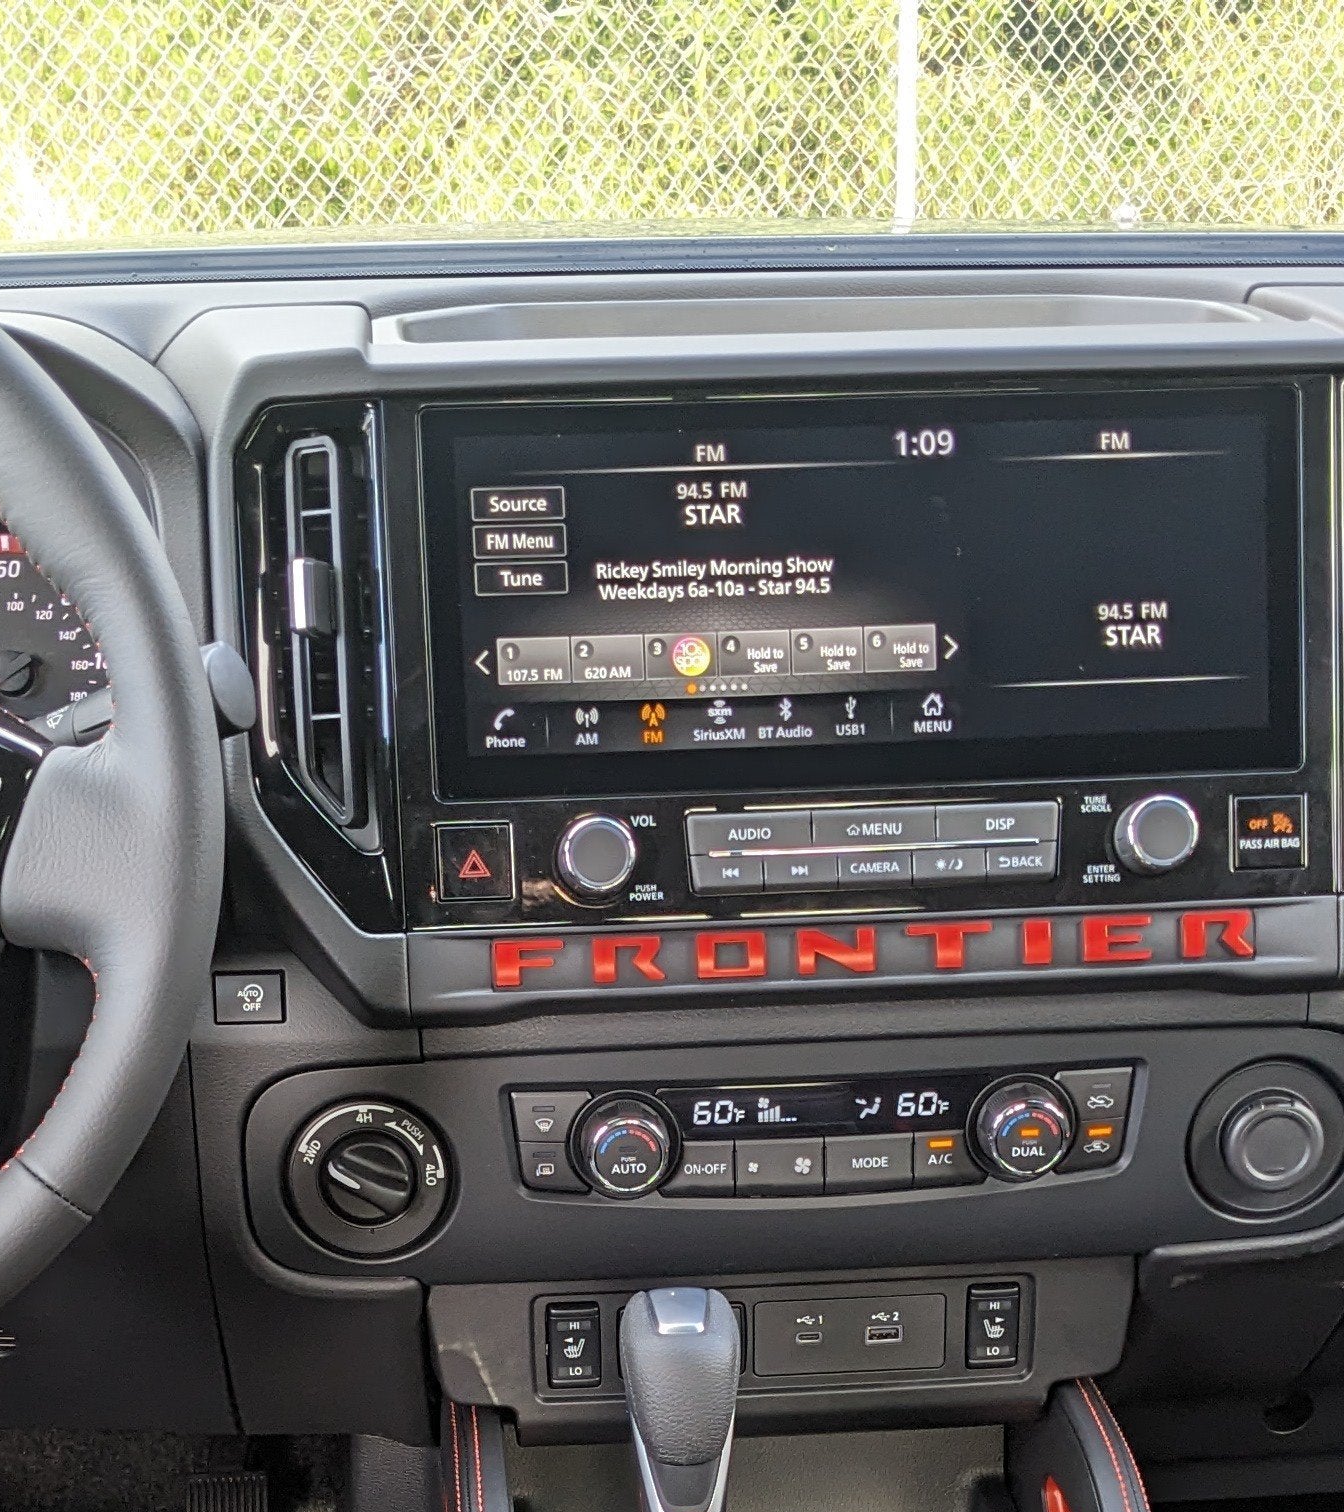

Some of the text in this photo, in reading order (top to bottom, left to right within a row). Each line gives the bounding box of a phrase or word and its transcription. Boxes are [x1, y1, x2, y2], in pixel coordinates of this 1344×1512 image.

[894, 429, 955, 457] 1:09
[1100, 432, 1130, 450] FM
[695, 444, 726, 462] FM
[677, 481, 747, 499] 94.5 FM
[489, 496, 547, 513] Source
[685, 504, 741, 525] STAR
[486, 533, 553, 550] FM Menu
[596, 556, 834, 582] Rickey Smiley Morning Show
[501, 570, 543, 587] Tune
[599, 582, 684, 602] Weekdays
[688, 581, 744, 598] 6a-10a
[759, 579, 792, 596] Star
[795, 577, 831, 595] 94.5
[6, 601, 24, 611] 100
[1097, 601, 1168, 621] 94.5 FM
[35, 611, 52, 620] 120
[1105, 625, 1161, 646] STAR
[747, 648, 784, 660] Hold to
[820, 646, 857, 658] Hold to
[893, 643, 929, 655] Hold to
[754, 662, 778, 673] Save
[827, 659, 851, 671] Save
[899, 657, 923, 669] Save
[506, 668, 563, 682] 107.5 FM
[584, 666, 631, 680] 620 AM
[758, 724, 813, 739] BT Audio
[836, 723, 865, 736] USB1
[913, 720, 953, 733] MENU
[485, 735, 525, 748] Phone
[575, 733, 598, 746] AM
[643, 731, 663, 743] FM
[693, 728, 745, 742] SiriusXM
[1080, 803, 1112, 813] SCROLL
[631, 815, 656, 827] VOL
[985, 817, 1015, 832] DISP
[1248, 818, 1269, 831] OFF
[727, 826, 772, 841] AUDIO
[862, 822, 903, 837] MENU
[1239, 837, 1300, 850] PASS AIR BAG
[850, 860, 900, 875] CAMERA
[1011, 854, 1043, 869] BACK
[1087, 864, 1115, 874] ENTER
[1082, 873, 1121, 884] SETTING
[635, 884, 657, 892] PUSH
[629, 891, 664, 901] POWER
[490, 910, 1256, 988] FRONTIER
[237, 989, 259, 998] AUTO
[242, 1002, 262, 1012] OFF
[356, 1113, 372, 1123] 4H
[401, 1119, 425, 1141] PUSH
[303, 1139, 322, 1165] 2WD
[1011, 1145, 1046, 1157] DUAL
[852, 1156, 889, 1171] MODE
[927, 1152, 953, 1166] A/C
[425, 1163, 437, 1186] 4LO
[611, 1163, 647, 1175] AUTO
[989, 1302, 1001, 1311] HI
[818, 1315, 823, 1325] 1
[892, 1311, 900, 1321] 2
[569, 1321, 580, 1330] HI
[986, 1346, 1000, 1356] LO
[569, 1367, 583, 1376] LO
